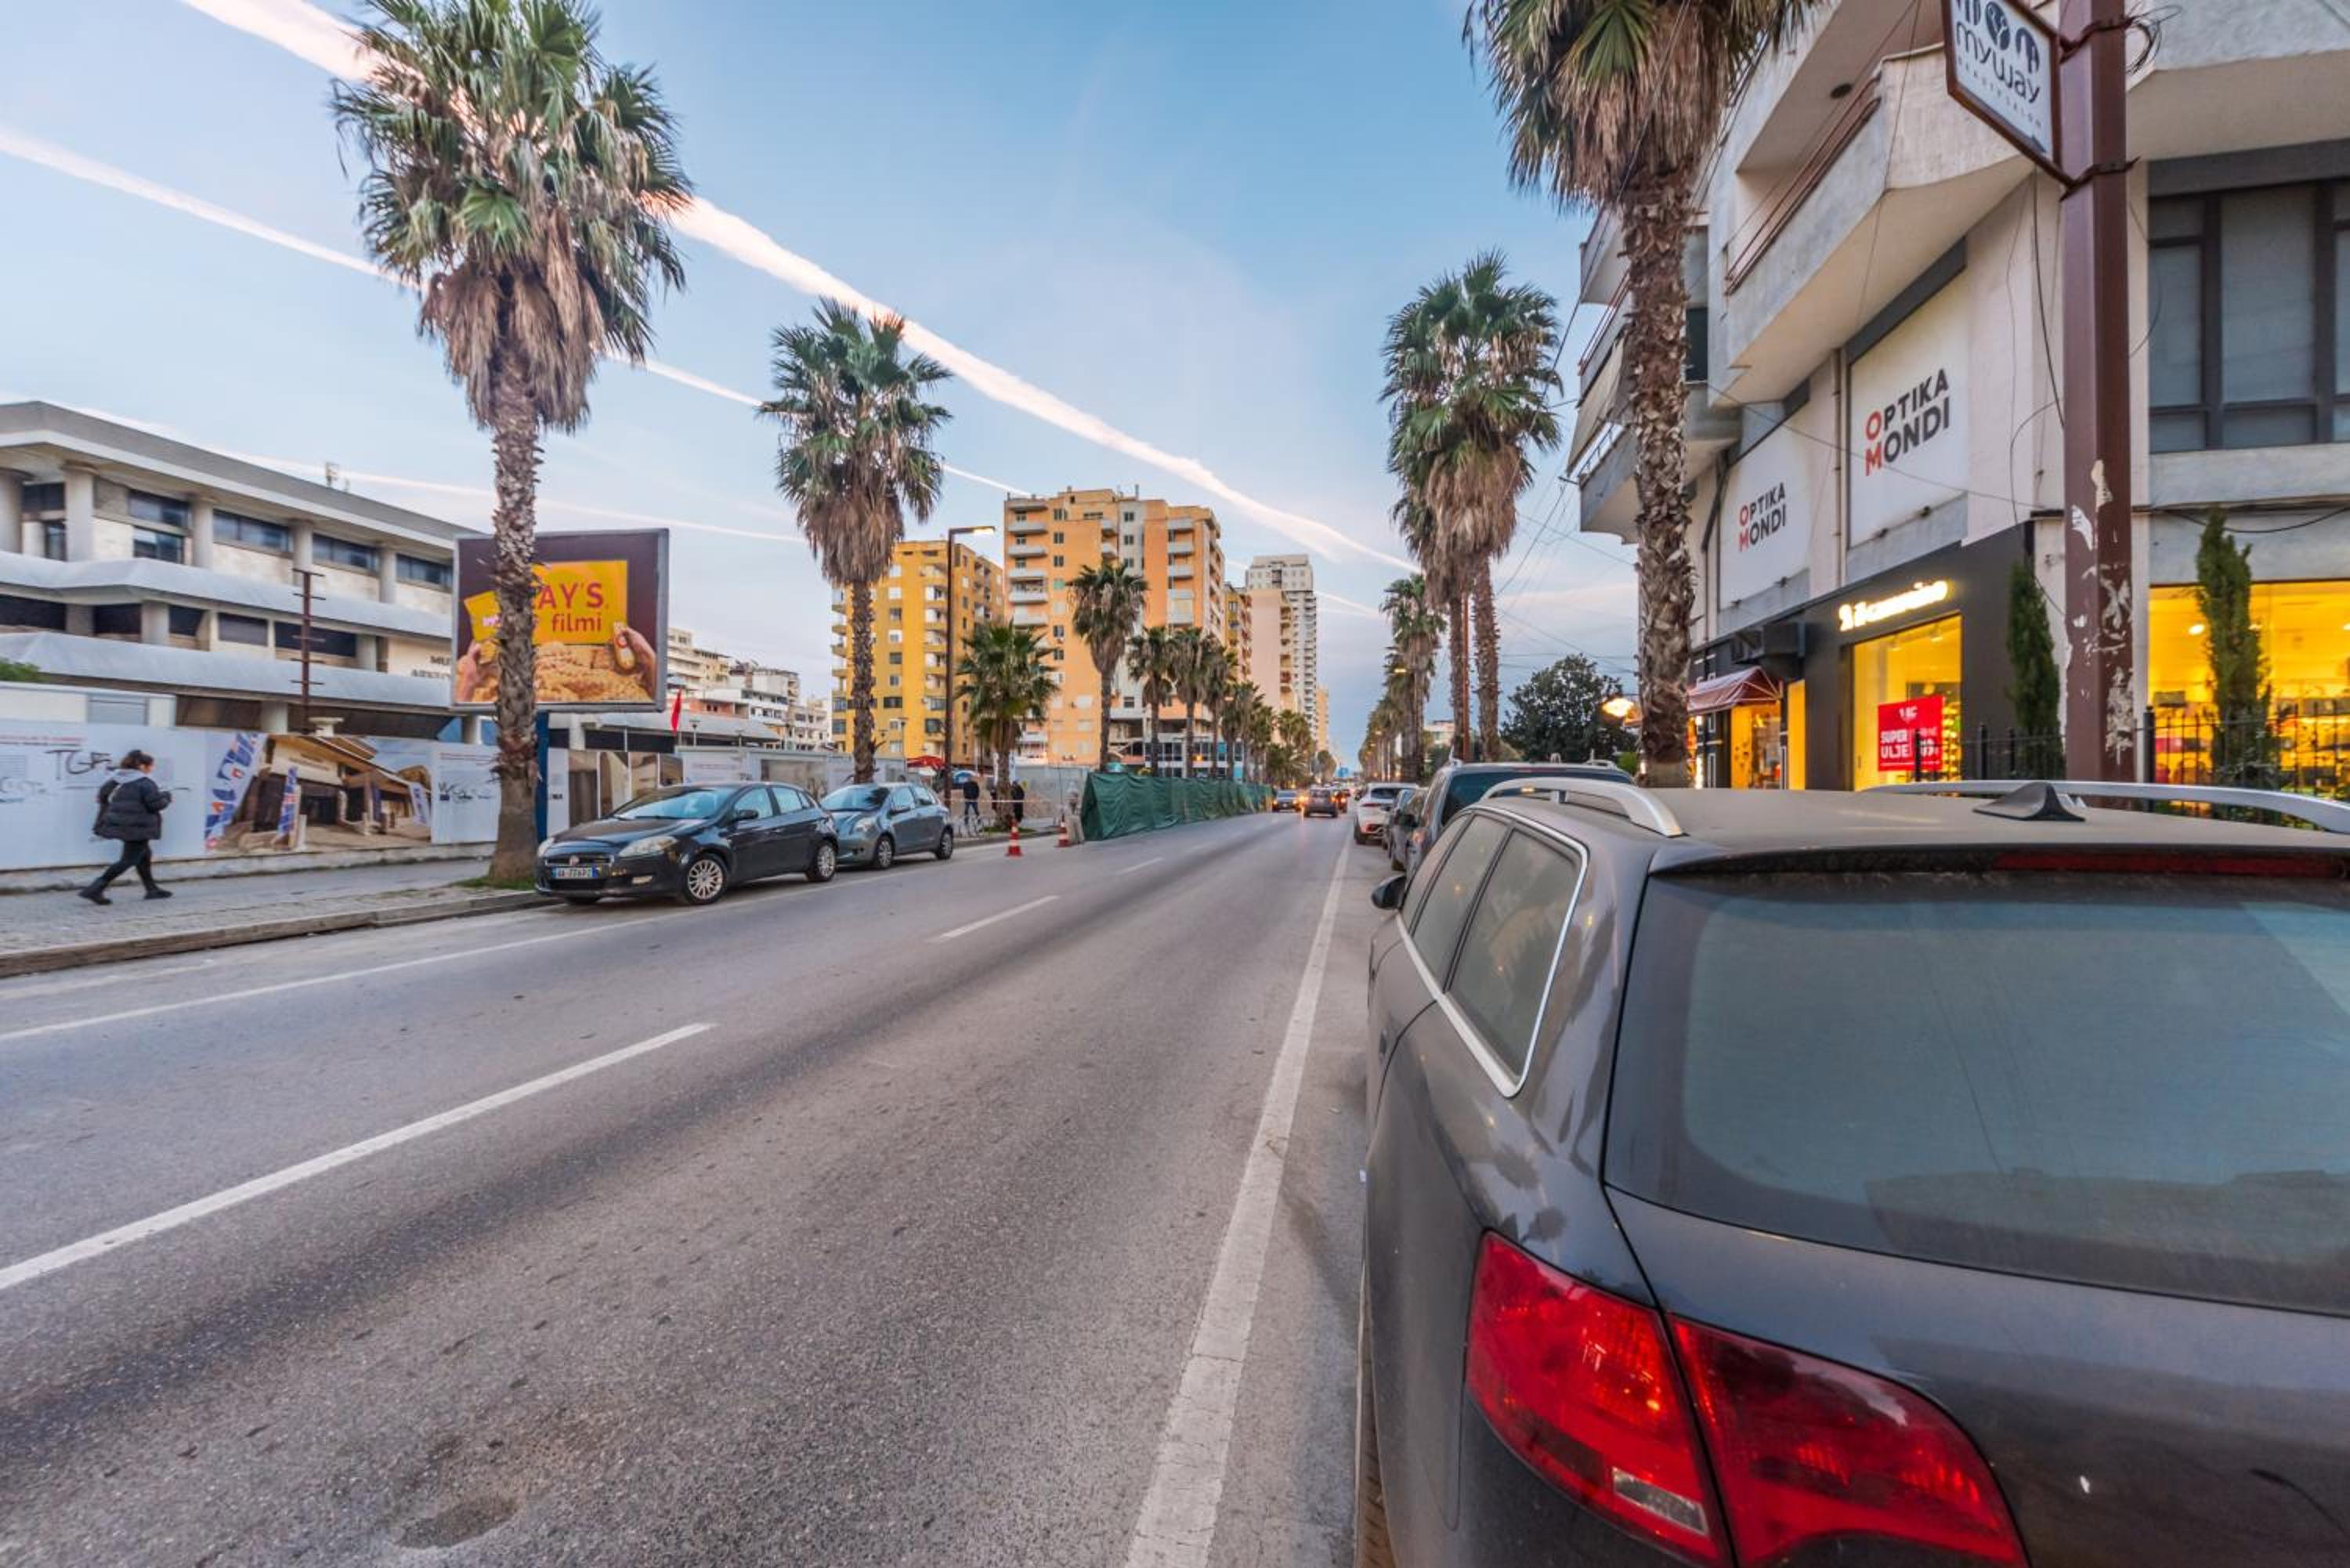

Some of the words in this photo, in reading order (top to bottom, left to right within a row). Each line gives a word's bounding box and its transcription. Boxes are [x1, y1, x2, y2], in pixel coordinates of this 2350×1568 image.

[1956, 21, 2040, 103] myway
[1865, 368, 1950, 441] OPTIKA
[1865, 397, 1950, 477] MONDI
[1739, 482, 1786, 527] OPTIKA
[1739, 505, 1787, 551] MONDI
[534, 583, 603, 609] AY'S
[551, 612, 602, 633] filmi
[1881, 743, 1910, 759] ULJE
